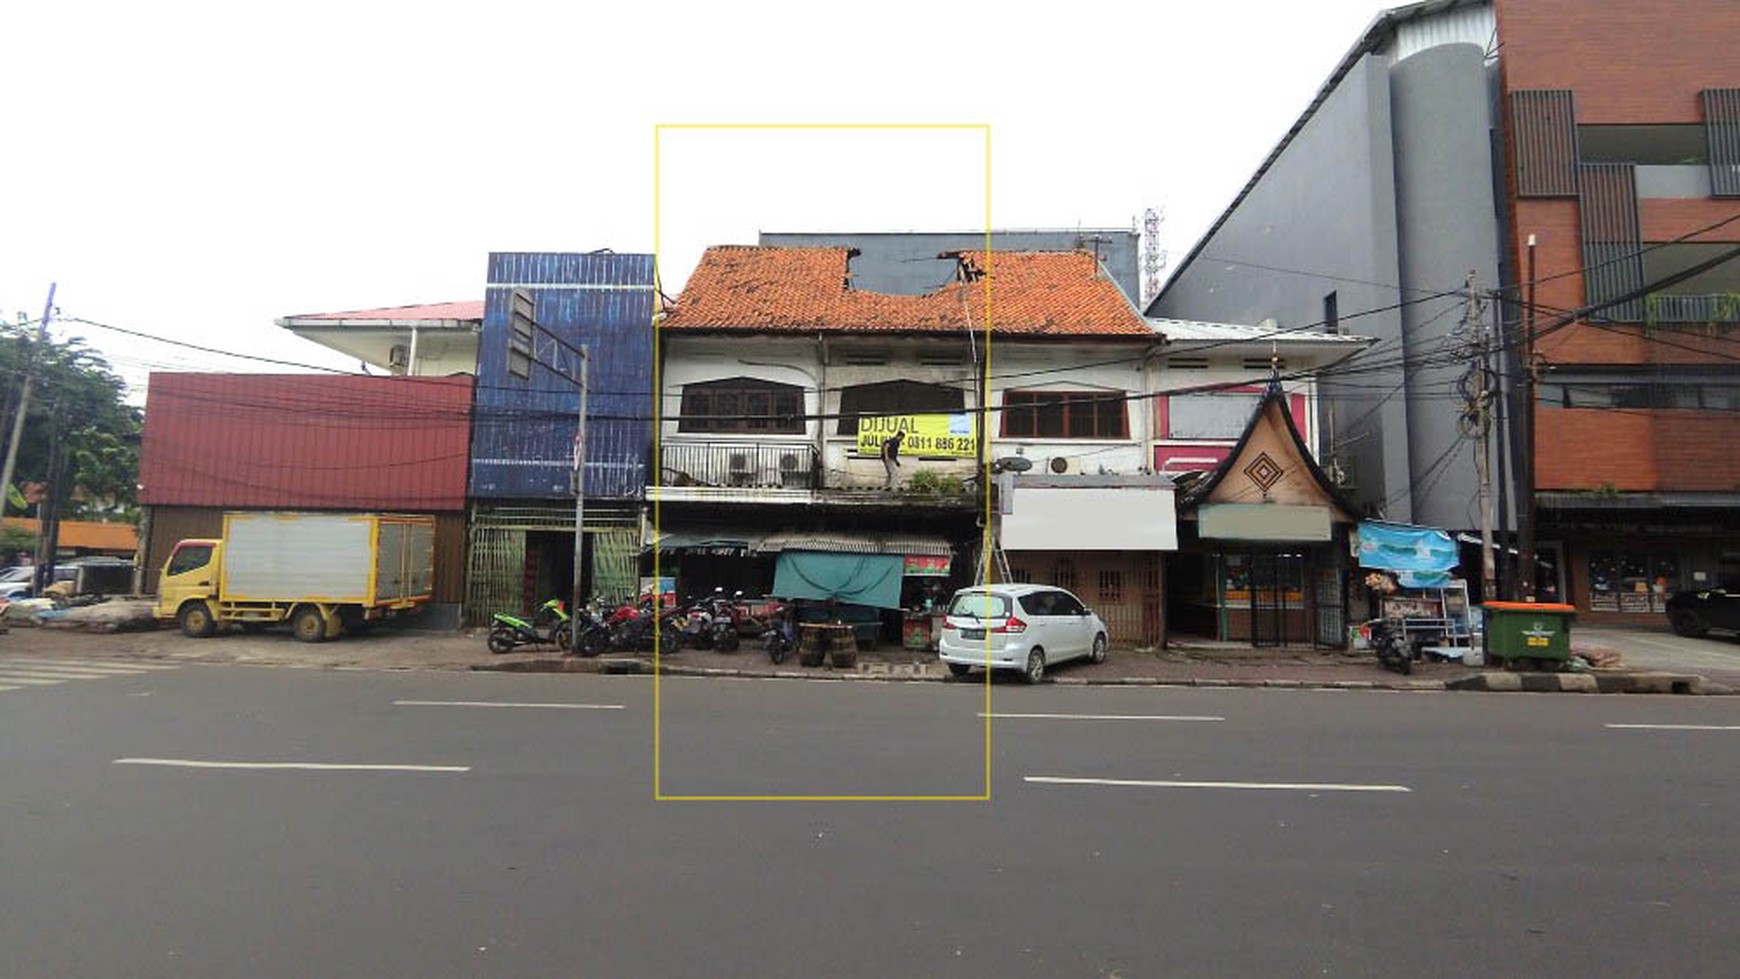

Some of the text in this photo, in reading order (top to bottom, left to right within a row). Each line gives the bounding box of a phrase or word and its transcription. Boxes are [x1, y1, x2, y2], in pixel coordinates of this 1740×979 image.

[861, 416, 918, 433] DIJUAL
[907, 436, 932, 449] 0811
[957, 437, 975, 451] 221
